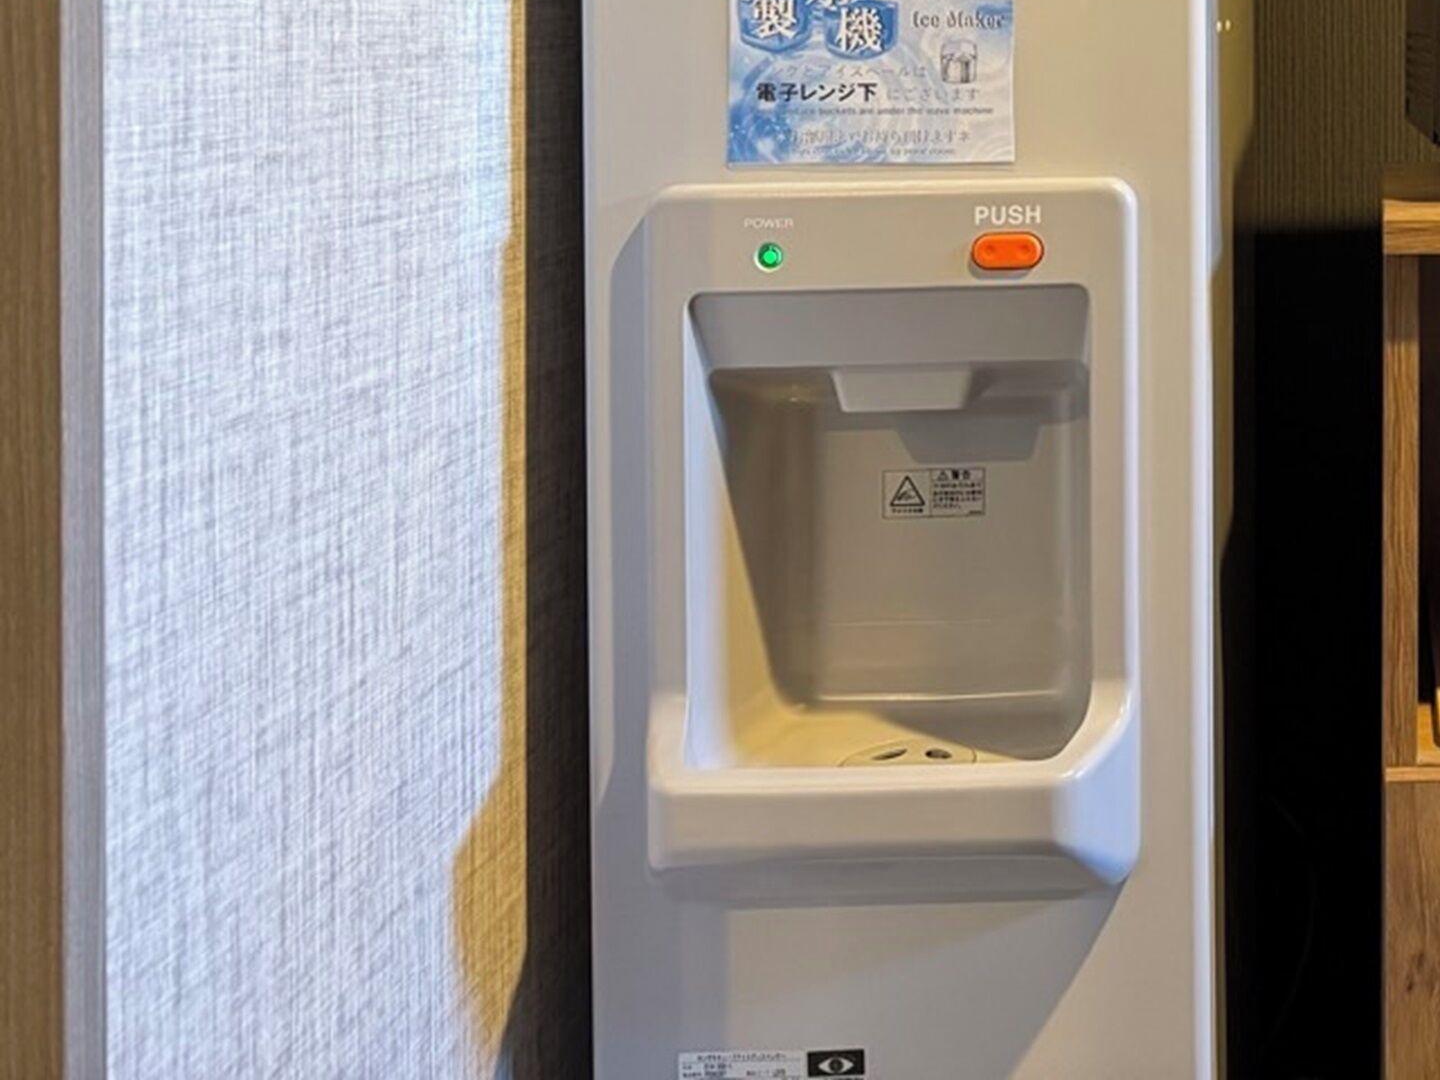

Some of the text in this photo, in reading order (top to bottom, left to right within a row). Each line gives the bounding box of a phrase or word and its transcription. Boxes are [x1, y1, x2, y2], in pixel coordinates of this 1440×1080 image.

[912, 10, 940, 29] Ice
[756, 82, 878, 102] 電子レンジ下
[744, 217, 794, 229] POWER
[974, 205, 1042, 226] PUSH
